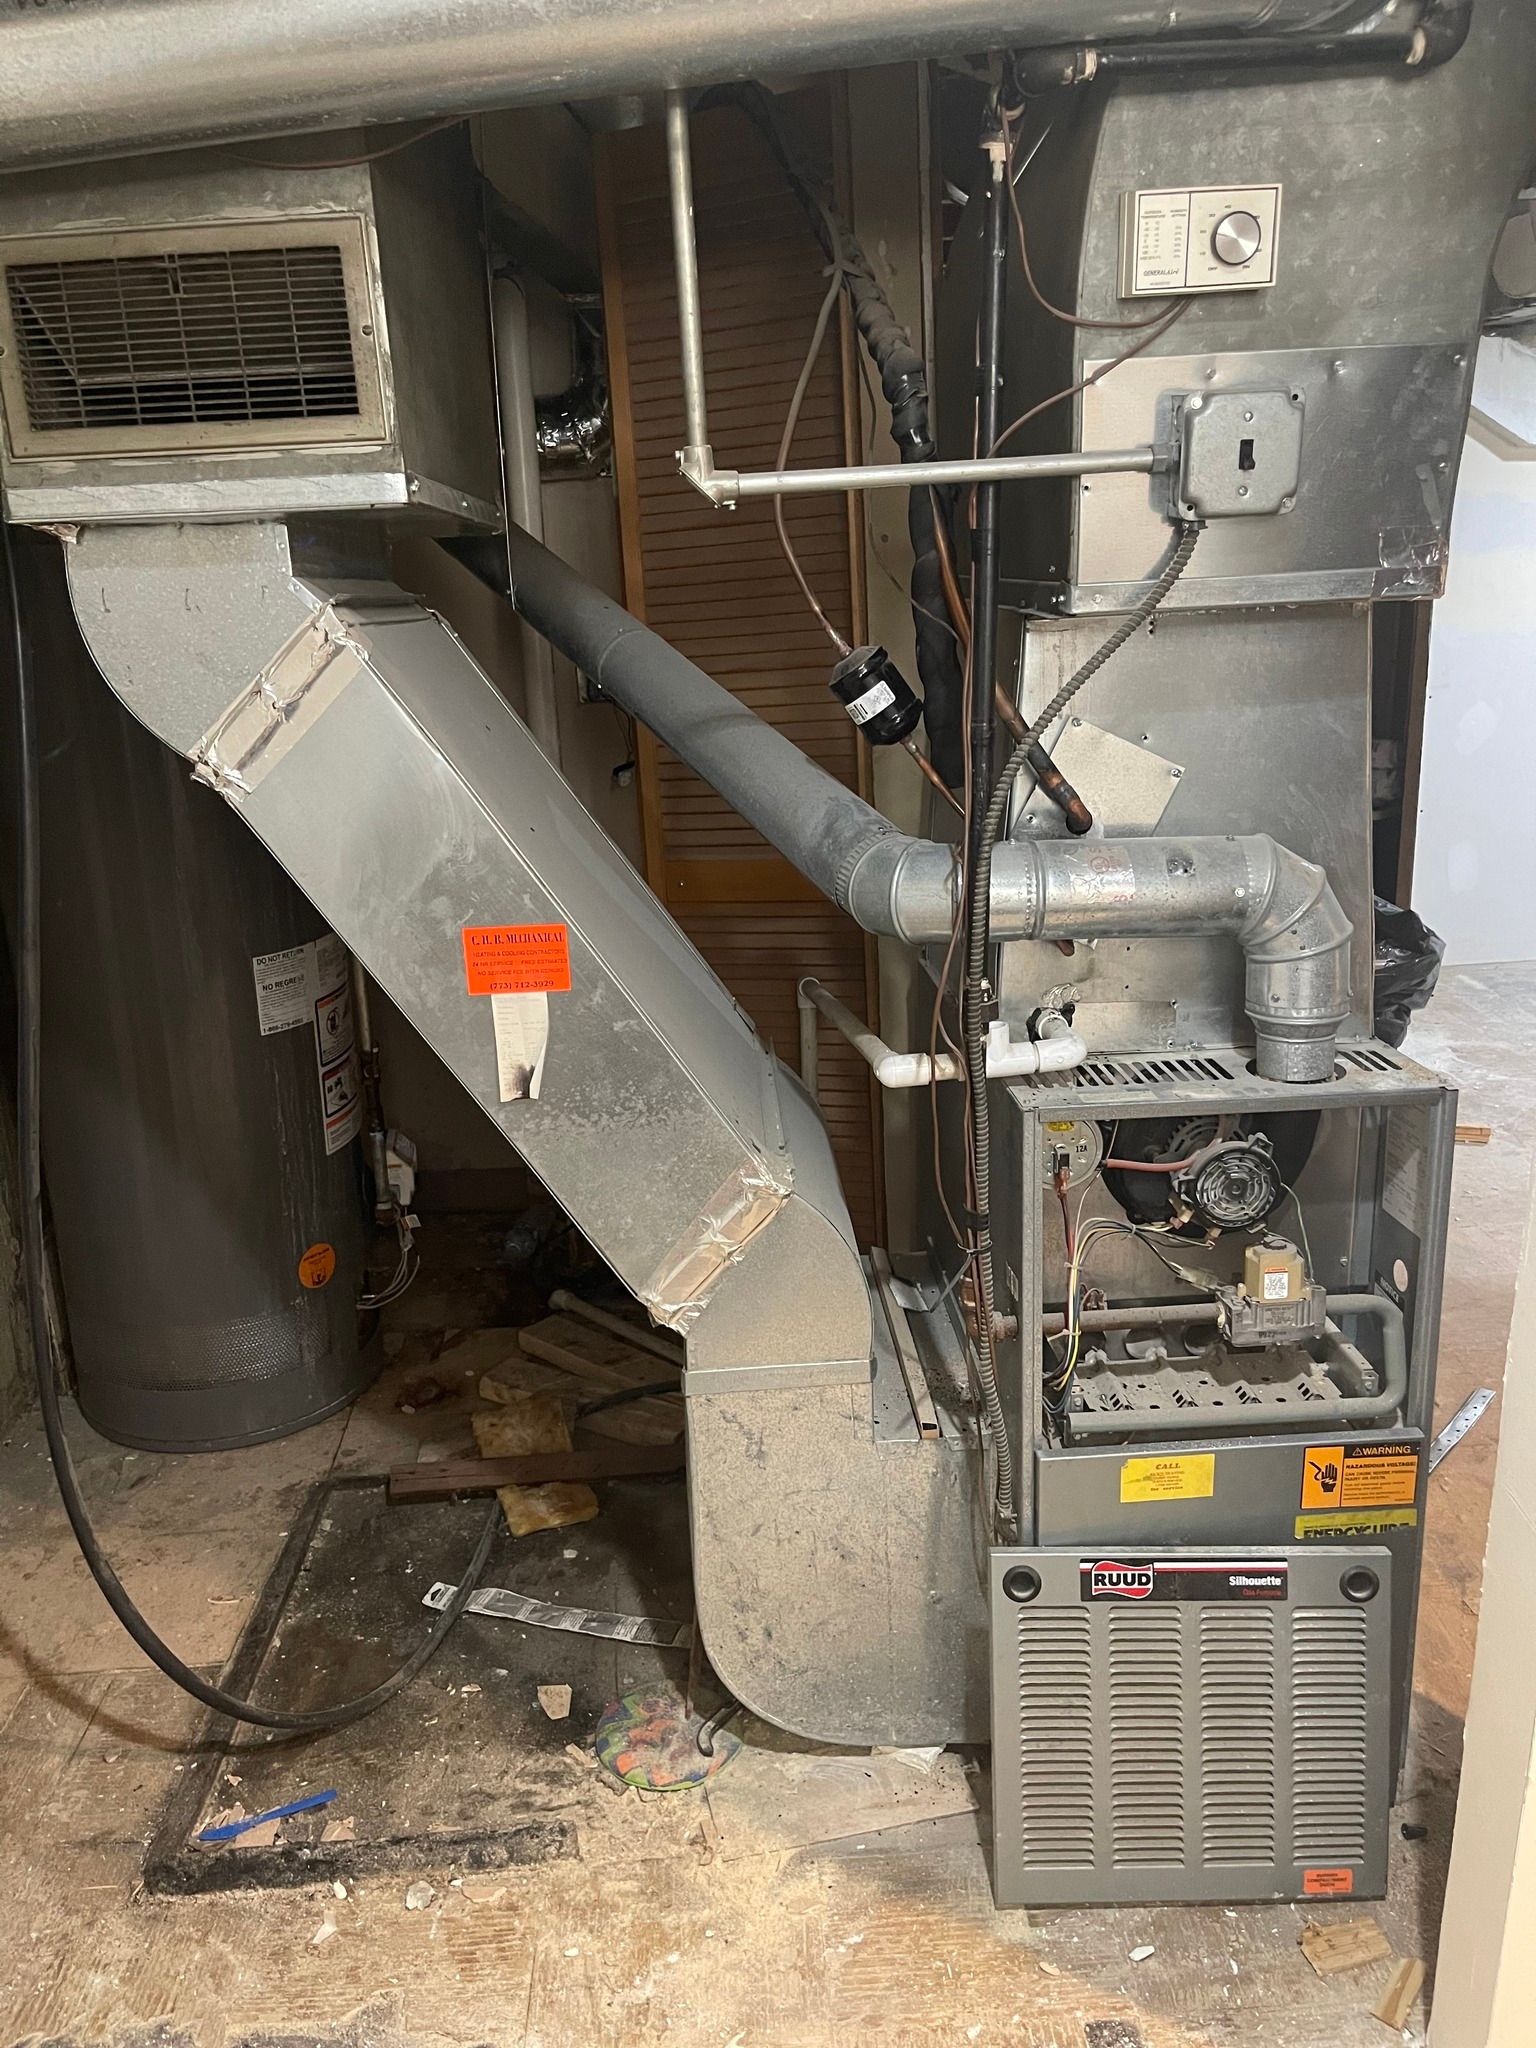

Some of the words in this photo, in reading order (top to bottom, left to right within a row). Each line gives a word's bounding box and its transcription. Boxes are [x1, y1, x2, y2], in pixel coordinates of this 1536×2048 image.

[506, 931, 565, 944] MECHANICAL
[257, 958, 266, 966] DO
[267, 953, 281, 963] NOT
[262, 983, 274, 991] NO
[490, 981, 512, 990] (773)
[514, 979, 554, 989] 712-3929
[1075, 1145, 1088, 1153] 12A
[1362, 1445, 1411, 1455] WARNING
[1094, 1573, 1152, 1587] RUUD
[1229, 1575, 1282, 1586] Silhouette
